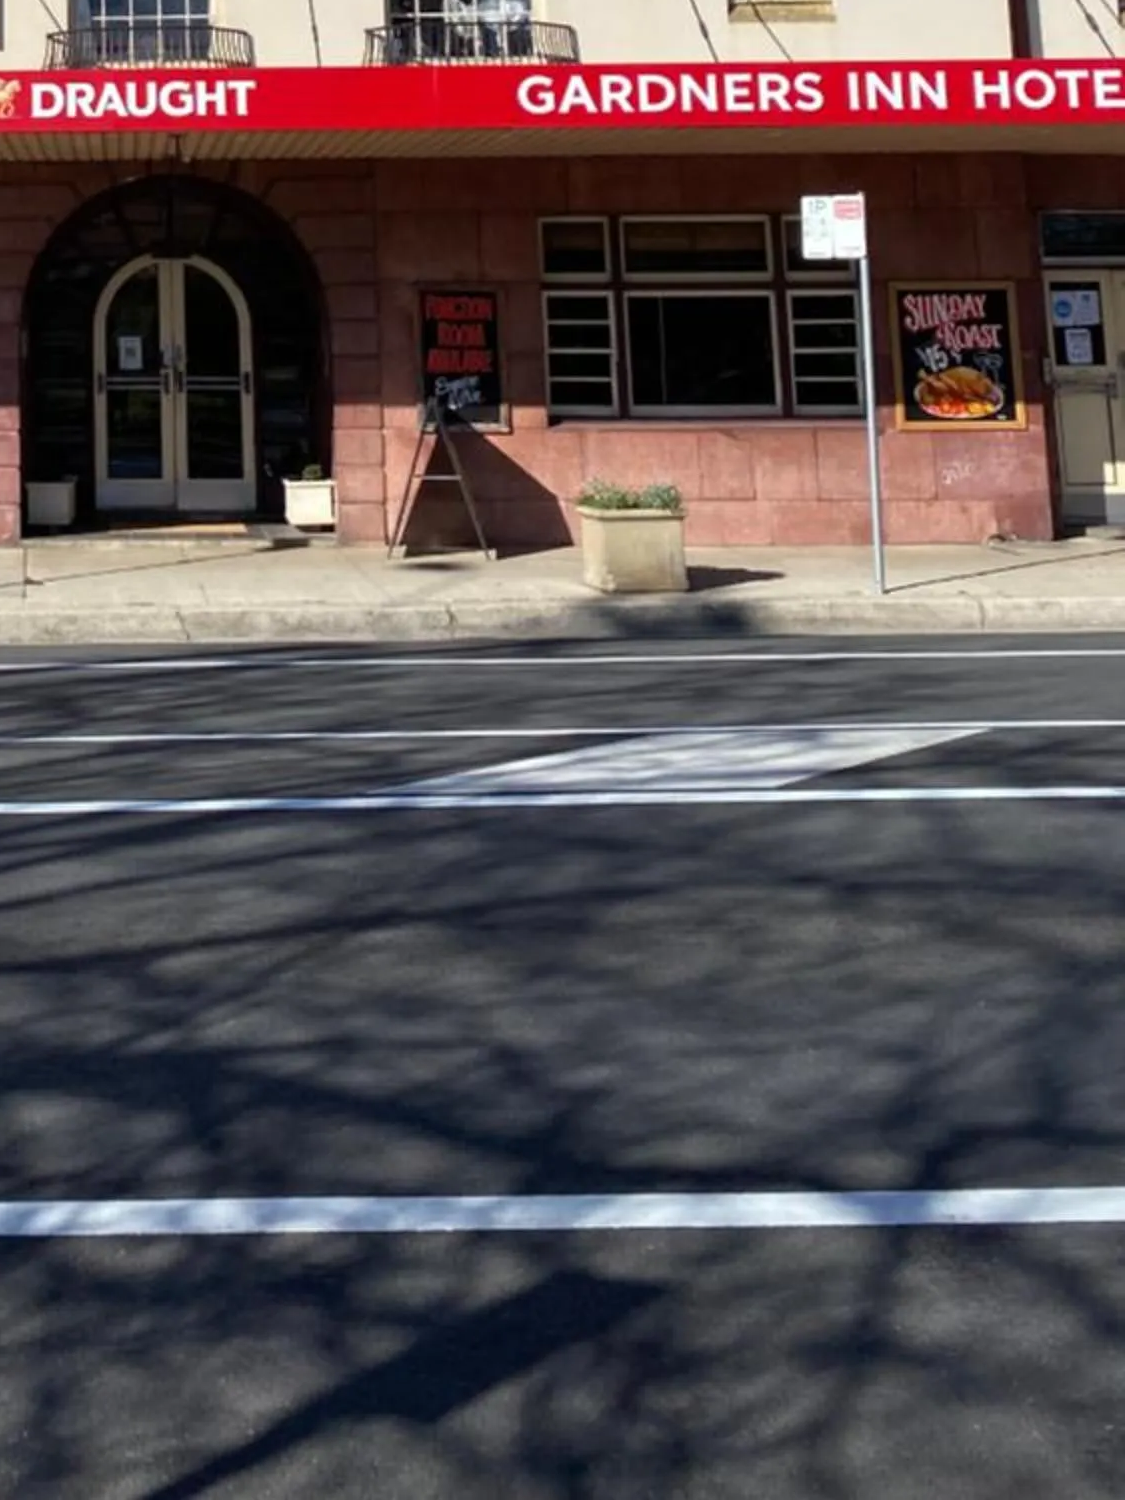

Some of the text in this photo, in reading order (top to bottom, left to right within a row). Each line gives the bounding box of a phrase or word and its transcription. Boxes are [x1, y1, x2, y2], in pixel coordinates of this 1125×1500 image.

[29, 80, 256, 118] DRAUGHT
[516, 73, 824, 114] GARDNERS
[846, 70, 948, 111] INN
[903, 293, 988, 333] SUNDAY
[935, 323, 1003, 354] ROAST
